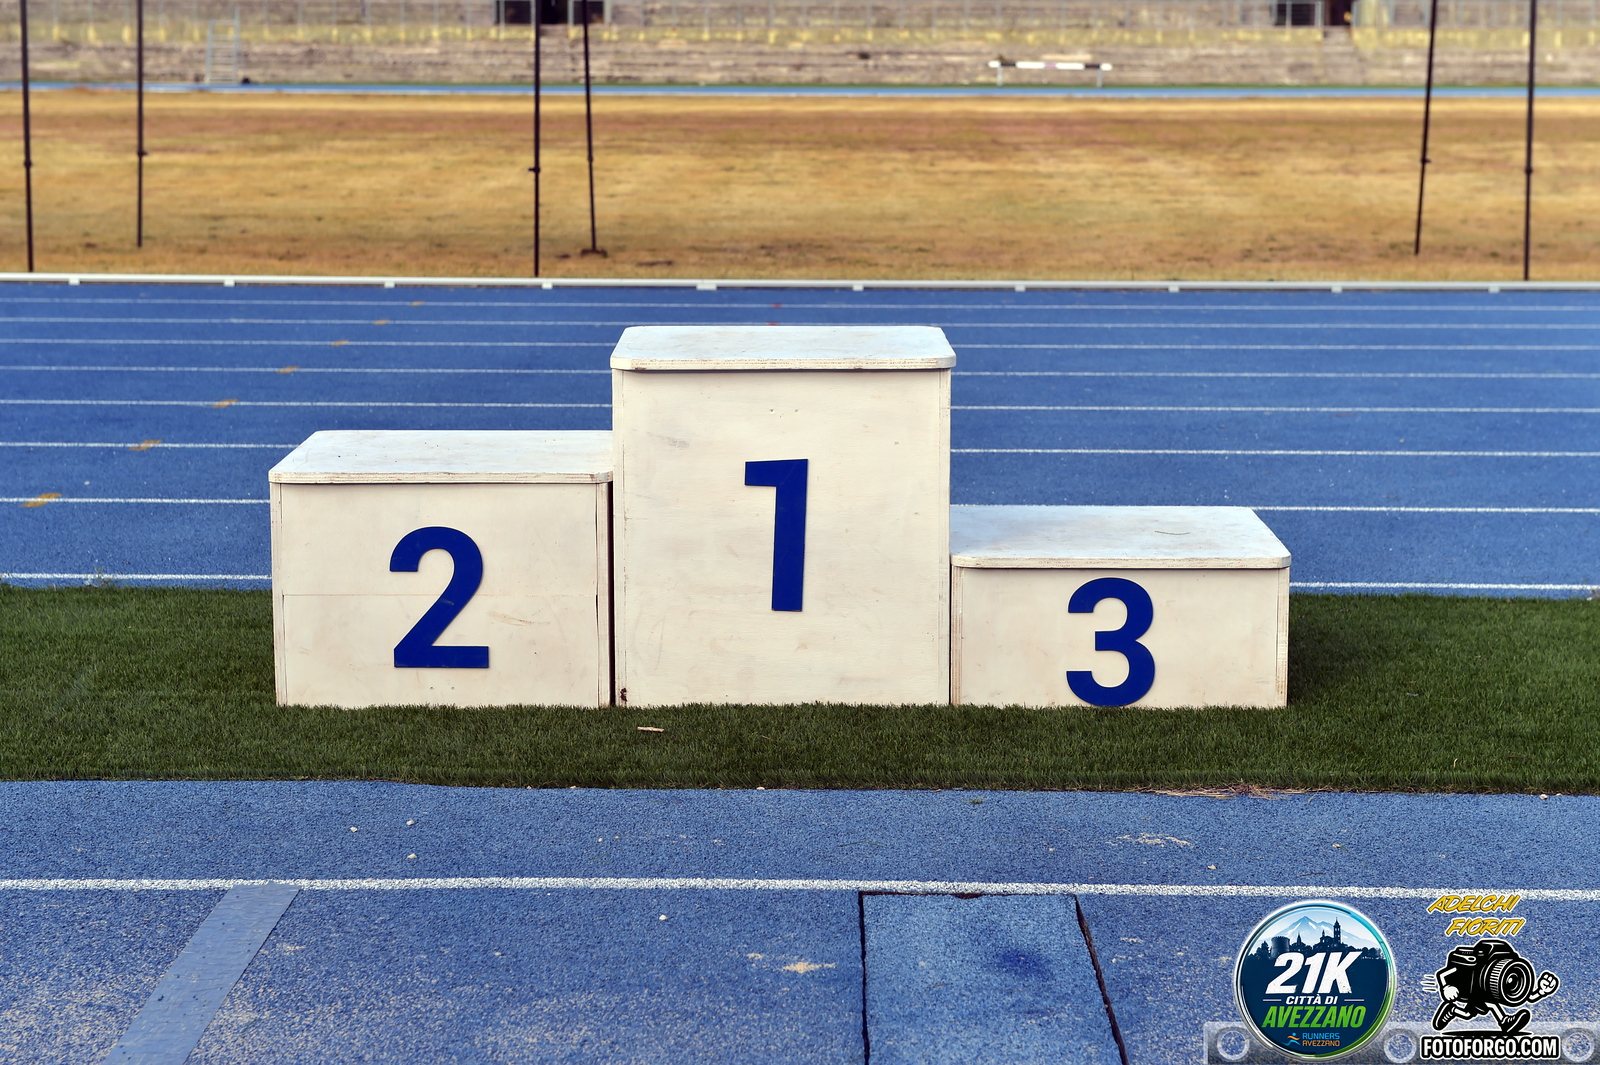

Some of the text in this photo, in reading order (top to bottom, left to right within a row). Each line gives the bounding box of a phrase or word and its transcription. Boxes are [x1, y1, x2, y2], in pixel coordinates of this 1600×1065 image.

[390, 527, 488, 668] 2
[745, 460, 807, 611] 1
[1067, 578, 1154, 707] 3
